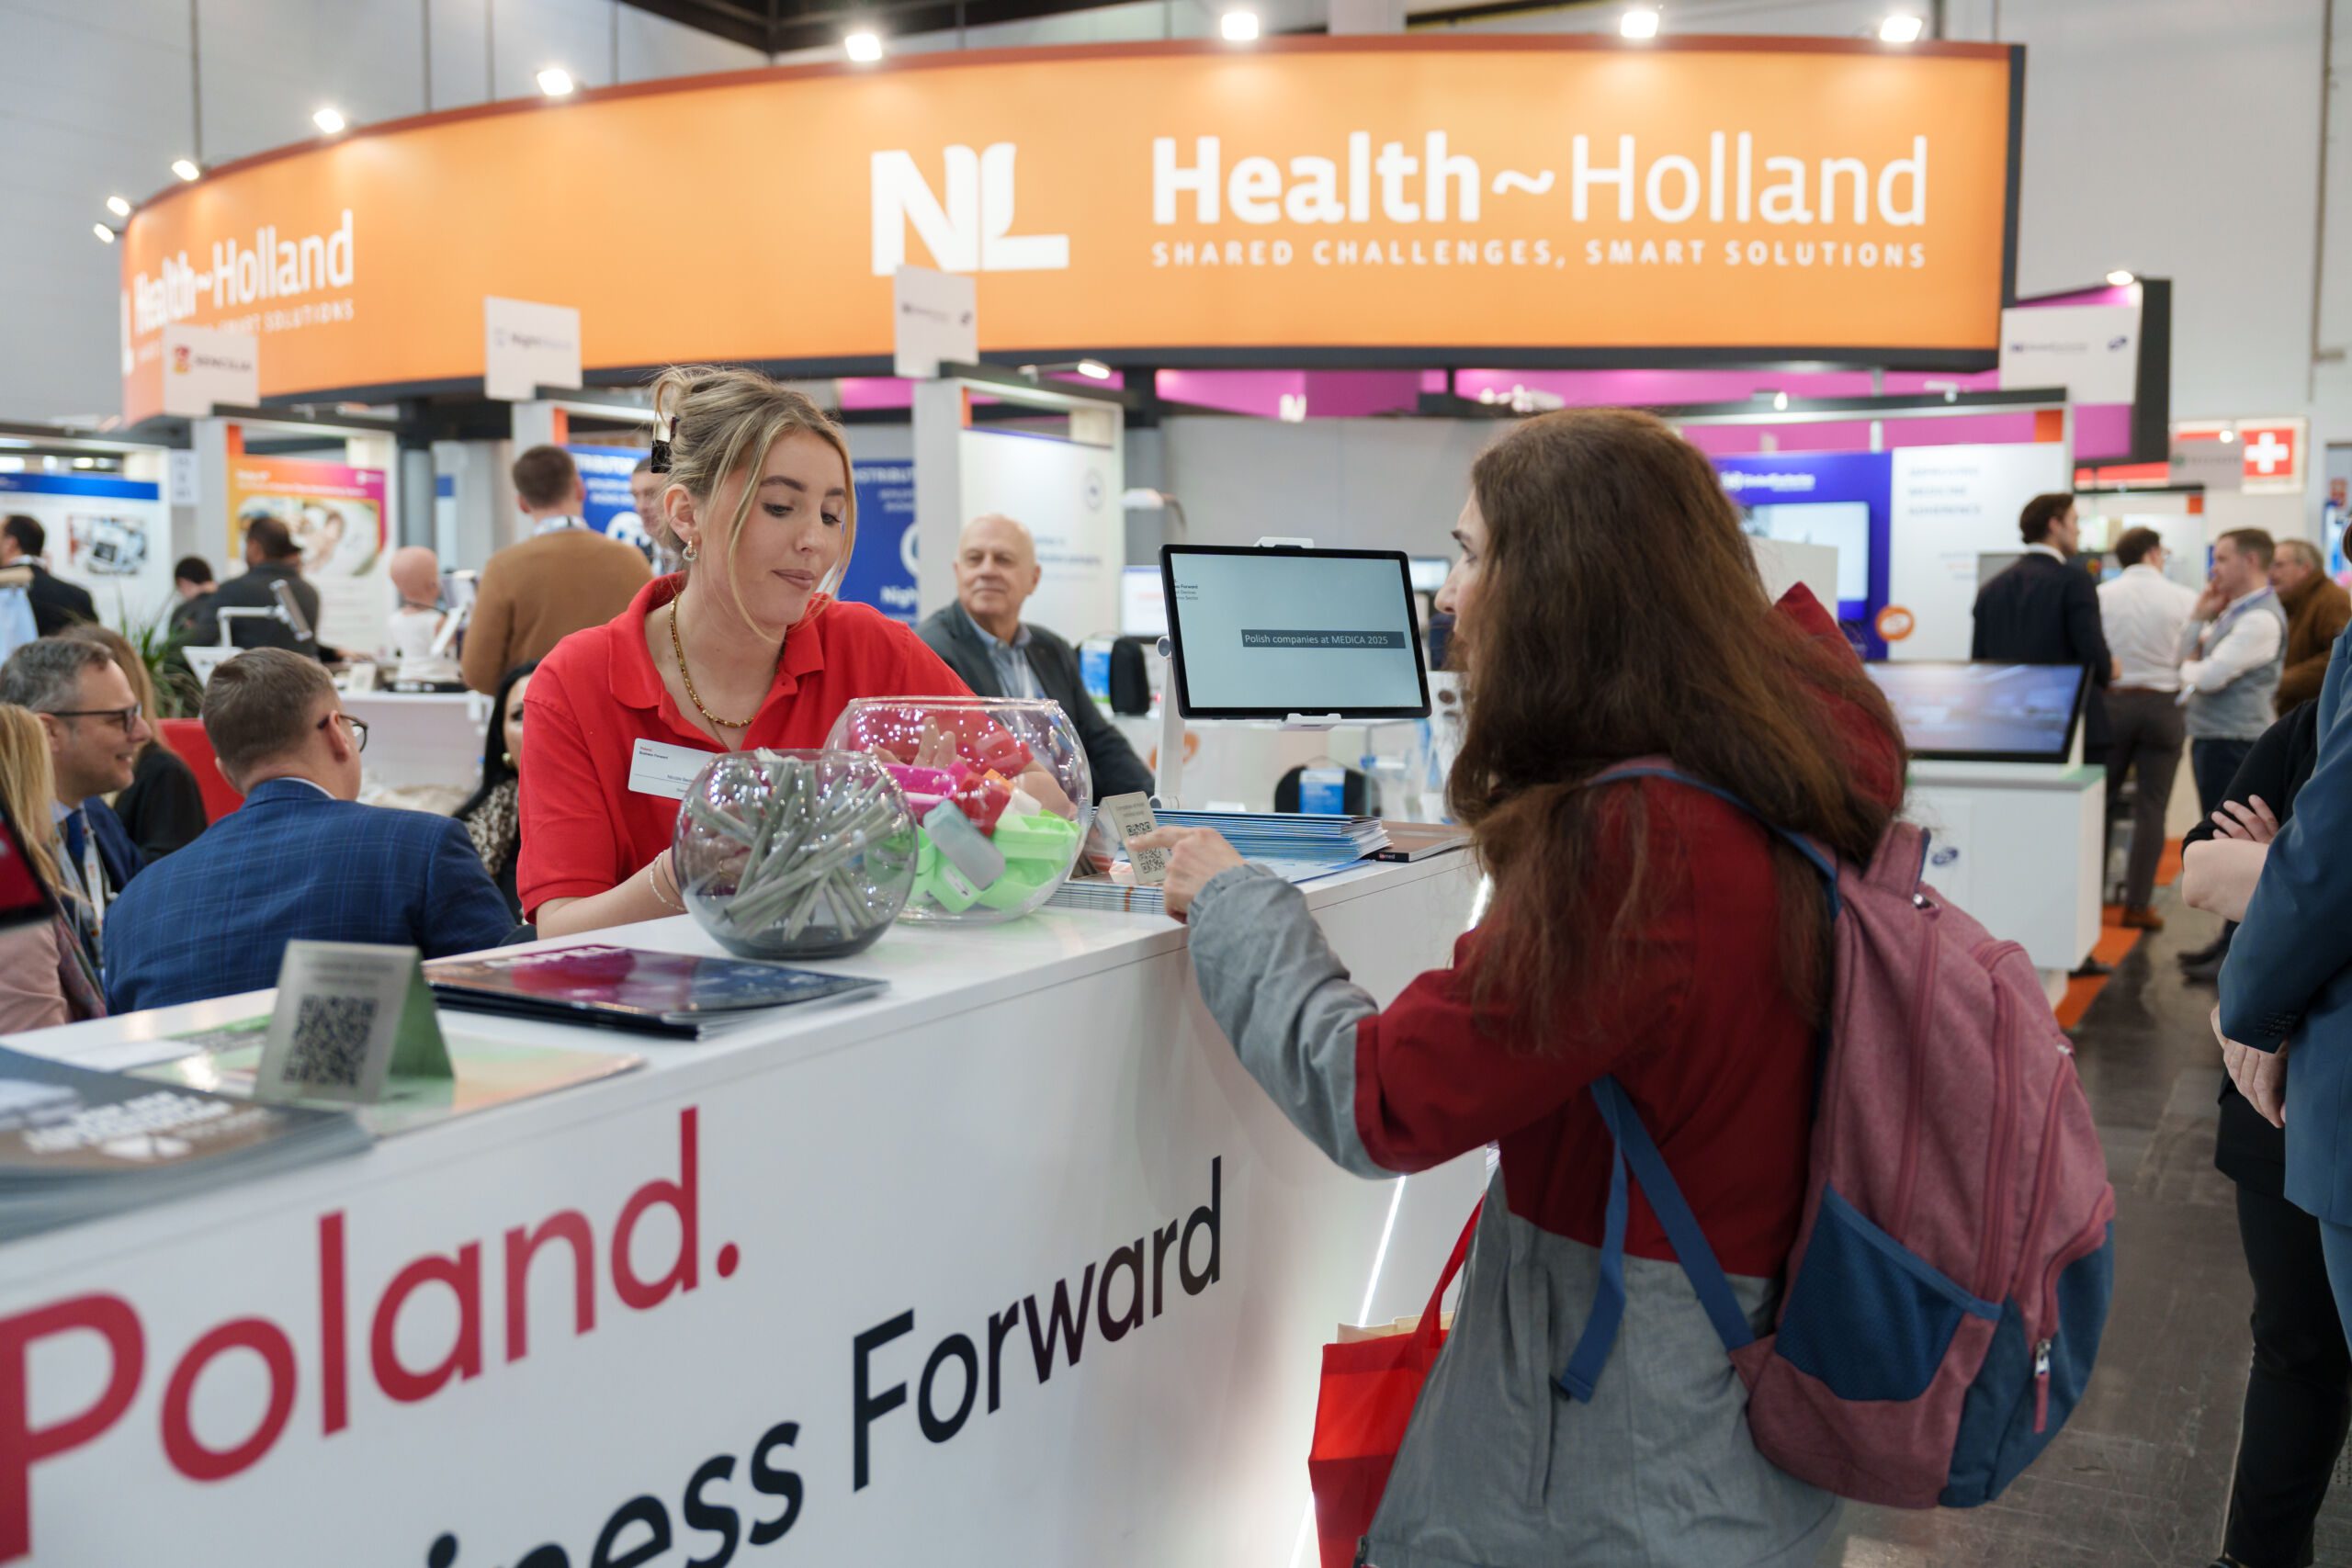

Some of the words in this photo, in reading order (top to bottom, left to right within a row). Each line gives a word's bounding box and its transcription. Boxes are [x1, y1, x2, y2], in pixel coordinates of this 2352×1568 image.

[871, 141, 1070, 276] NL
[1150, 239, 1294, 267] SHARED
[1312, 239, 1566, 269] CHALLENGES,
[1586, 238, 1706, 265] SMART
[1724, 240, 1926, 269] SOLUTIONS
[1245, 634, 1271, 644] Polish
[1272, 635, 1318, 646] companies
[1320, 636, 1330, 644] at
[1332, 636, 1365, 645] MEDICA
[1367, 636, 1388, 645] 2025
[0, 1105, 741, 1567] Poland.
[854, 1155, 1223, 1494] Forward
